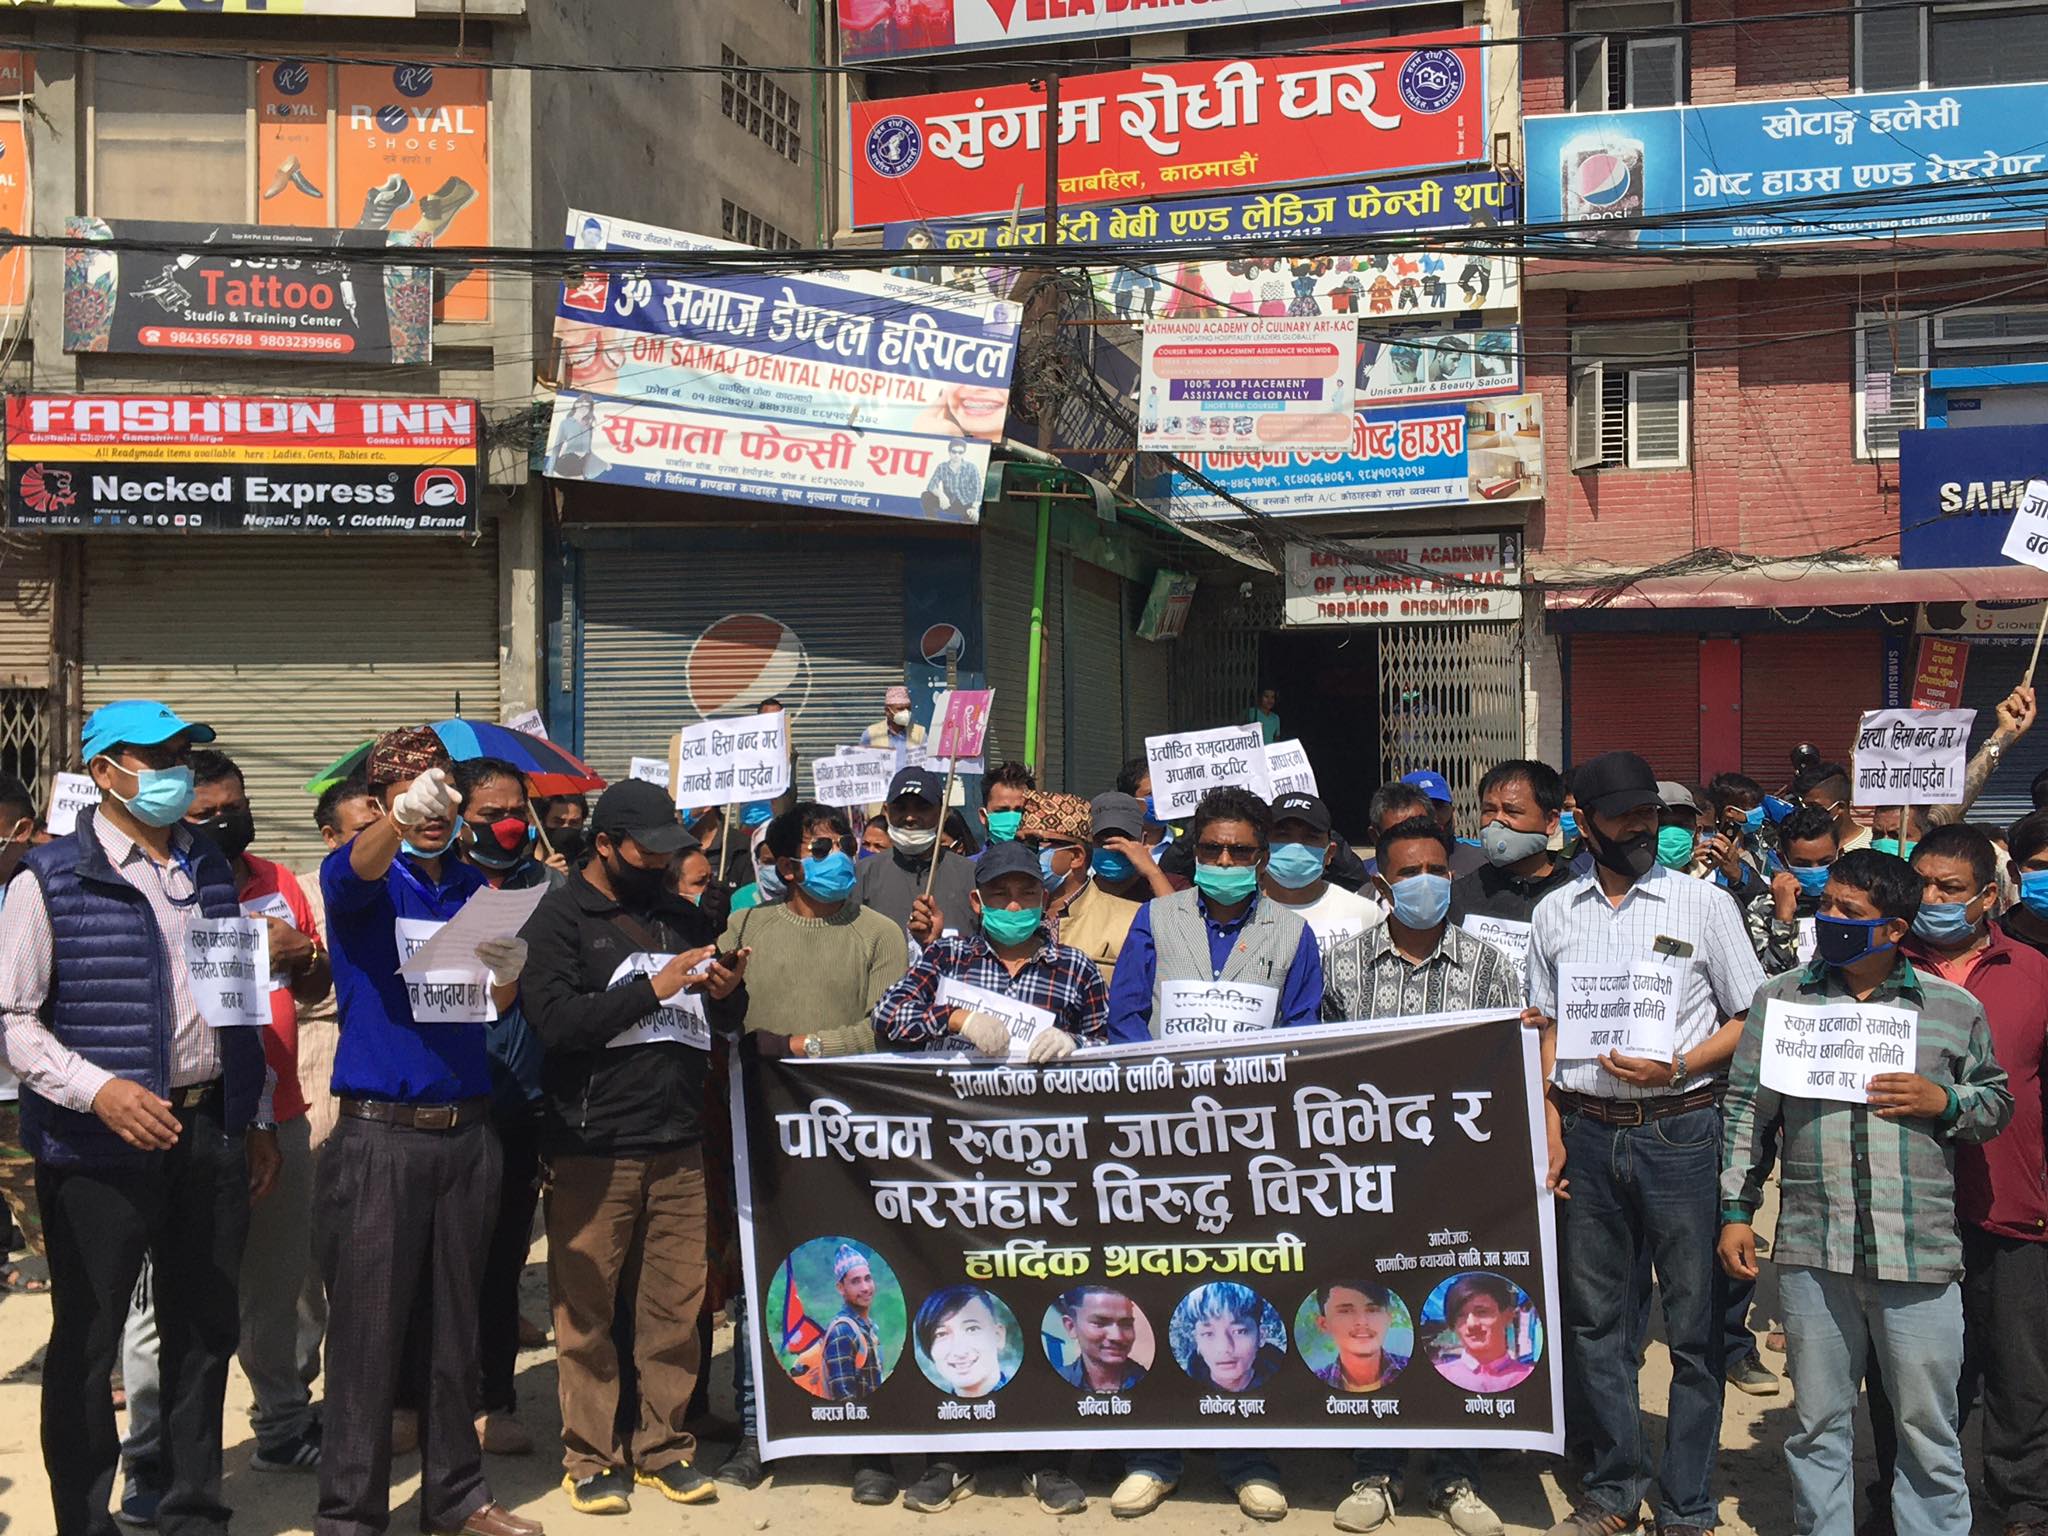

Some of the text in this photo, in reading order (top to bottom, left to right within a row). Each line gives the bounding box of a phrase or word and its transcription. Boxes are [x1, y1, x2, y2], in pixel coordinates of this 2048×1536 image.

[925, 96, 1106, 169] संगम
[1276, 61, 1401, 130] घर
[1869, 97, 1962, 134] हलेसी
[368, 137, 456, 151] SHOES
[1762, 166, 1843, 196] हाउस
[1852, 162, 1916, 189] एण्ड
[1109, 205, 1160, 239] बेबी
[1169, 206, 1233, 236] एण्ड
[1241, 193, 1337, 229] लेडिज
[1346, 180, 1444, 219] फेन्सी
[1454, 181, 1506, 212] शप
[200, 270, 334, 310] Tattoo
[184, 310, 343, 328] Studio & Training Center
[664, 280, 765, 337] समाज
[768, 286, 875, 357] डेण्टल
[878, 312, 1013, 378] हस्पिटल
[1145, 319, 1355, 335] KATHMANDU ACADEMY OF CULINARY ART-KAC
[1204, 347, 1216, 355] JOB
[1217, 347, 1256, 355] PLACEMENT
[1257, 347, 1295, 355] ASSISTANCE
[632, 336, 927, 402] OM SAMAJ DENTAL HOSPITAL
[1182, 390, 1310, 400] ASSISTANCE GLOBALLY
[1184, 379, 1306, 389] 100% JOB PLACEMENT
[1370, 376, 1513, 397] Unisex hair & Beauty Saloon
[30, 400, 471, 434] FASHION INN
[366, 436, 404, 445] Contact
[602, 414, 728, 454] सुजाता
[740, 424, 856, 470] फेन्सी
[867, 445, 933, 478] शप
[1400, 417, 1464, 460] हाउस
[96, 448, 109, 458] All
[111, 448, 164, 460] Readymade
[166, 449, 191, 458] items
[194, 449, 236, 458] available
[244, 450, 264, 459] here
[92, 476, 395, 509] Necked Express
[1318, 492, 1337, 502] A/C
[18, 516, 47, 524] SINCE
[243, 514, 466, 529] Nepal's No. 1 Clothing Brand
[1419, 545, 1497, 564] ACADEMY
[1314, 576, 1336, 595] OF
[1400, 596, 1490, 617] encounters
[1888, 650, 1899, 706] SAMSUNG
[737, 730, 760, 751] बन्द
[761, 729, 778, 750] गर
[1915, 727, 1938, 748] बन्द
[1938, 727, 1956, 748] गर
[1283, 798, 1312, 810] UFC
[423, 983, 465, 1014] समूदाय
[1633, 997, 1666, 1021] समिति
[1165, 1012, 1228, 1035] हस्तक्षेप
[1818, 1012, 1911, 1040] घटनाको समावेशी
[1611, 1030, 1624, 1045] गर
[1775, 1037, 1817, 1059] संसदीय
[1868, 1042, 1905, 1066] समिति
[1043, 1061, 1120, 1095] न्यायको
[1126, 1055, 1174, 1094] लागि
[1181, 1055, 1217, 1089] जन
[1807, 1070, 1857, 1089] गठन गर
[775, 1098, 932, 1161] पश्चिम
[1104, 1095, 1277, 1158] जातीय
[1293, 1083, 1435, 1150] विभेद
[1452, 1090, 1492, 1143] र
[870, 1171, 1078, 1230] नरसंहार
[1248, 1152, 1396, 1217] विरोध
[963, 1237, 1091, 1280] हार्दिक
[1375, 1250, 1501, 1273] सामाजिक न्यायको लागि जन
[938, 1399, 996, 1421] गोविन्द शाही
[1077, 1396, 1132, 1417] सन्दिप विक
[1199, 1394, 1266, 1418] लोकेन्द्र सुनार
[1326, 1394, 1400, 1419] टीकाराम सुनार
